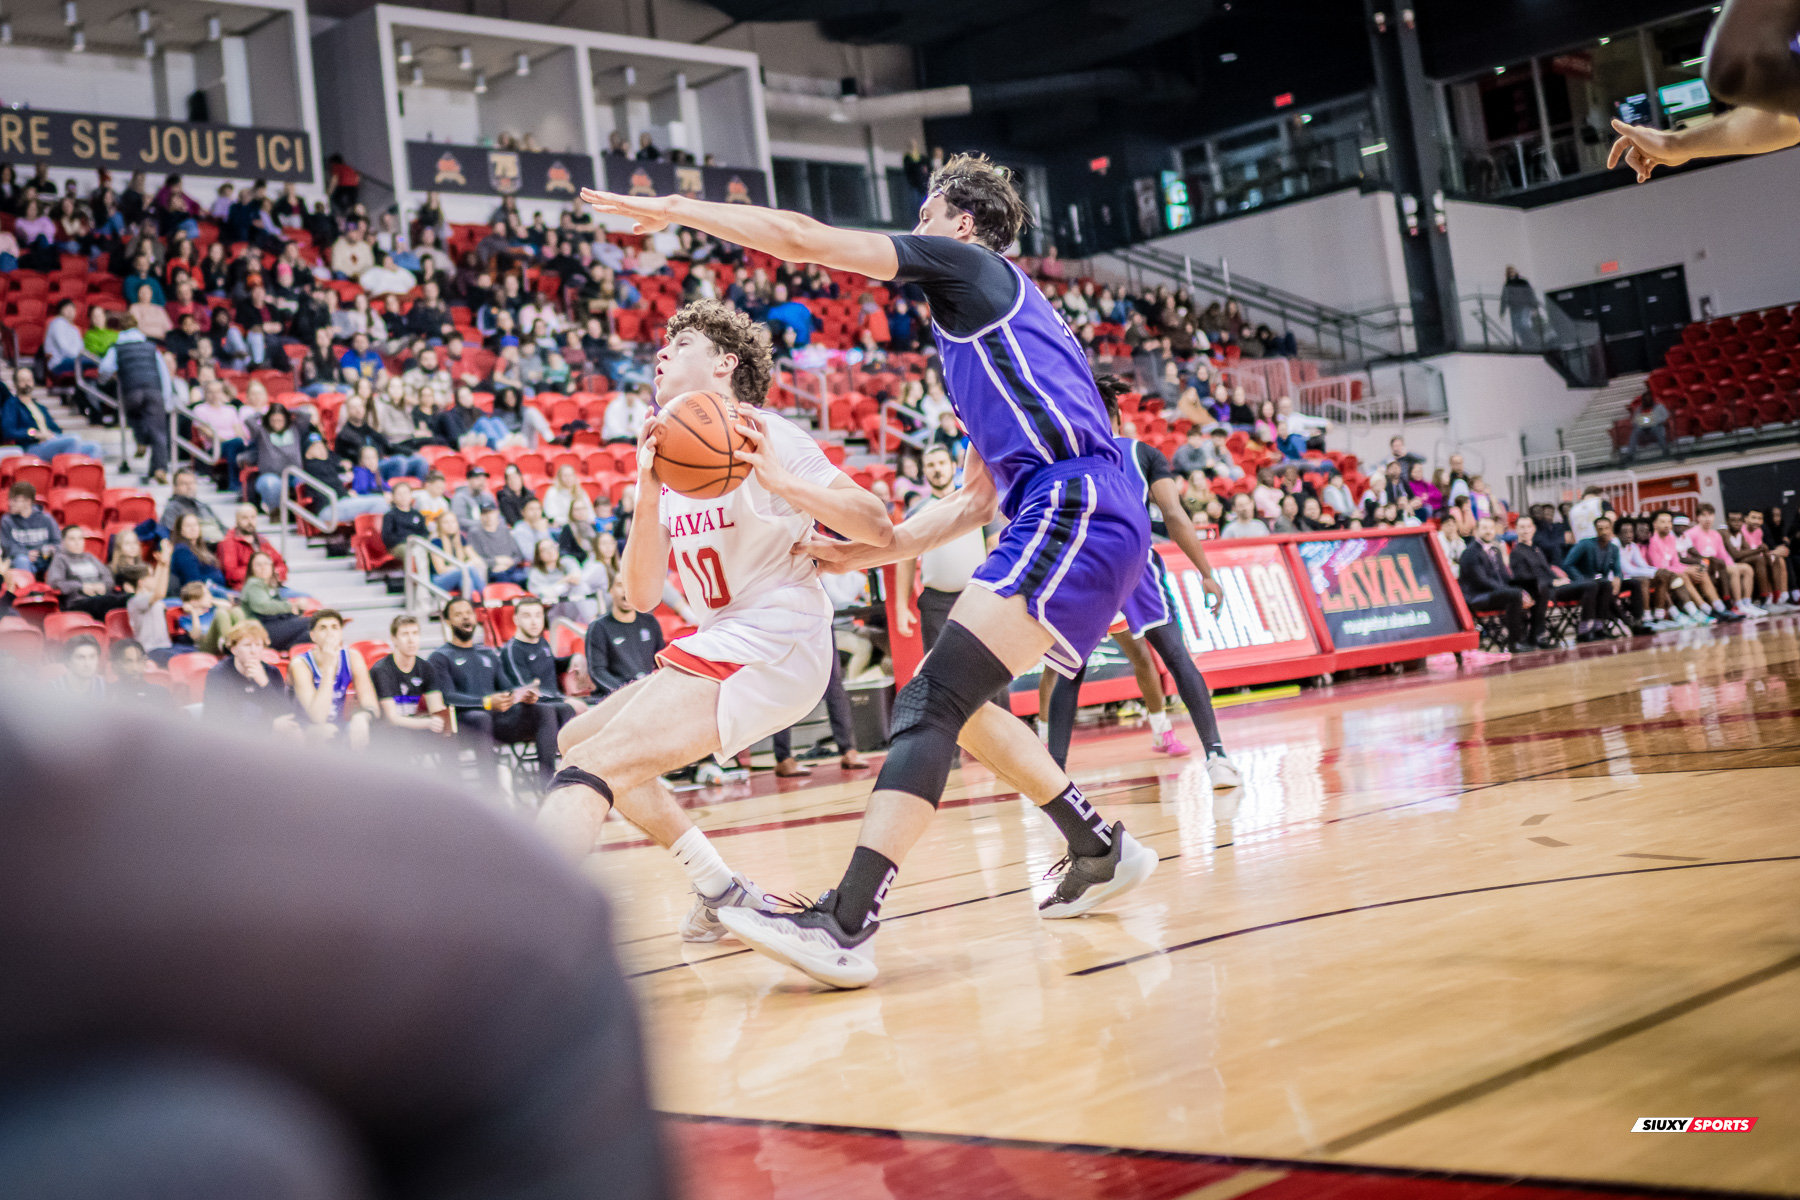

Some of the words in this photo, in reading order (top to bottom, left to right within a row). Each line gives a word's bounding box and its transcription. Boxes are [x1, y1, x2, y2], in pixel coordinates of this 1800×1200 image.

[71, 119, 121, 160] SE
[139, 125, 239, 169] JOUE
[256, 133, 305, 173] ICI
[681, 545, 733, 610] 10
[1320, 553, 1434, 614] LAVAL
